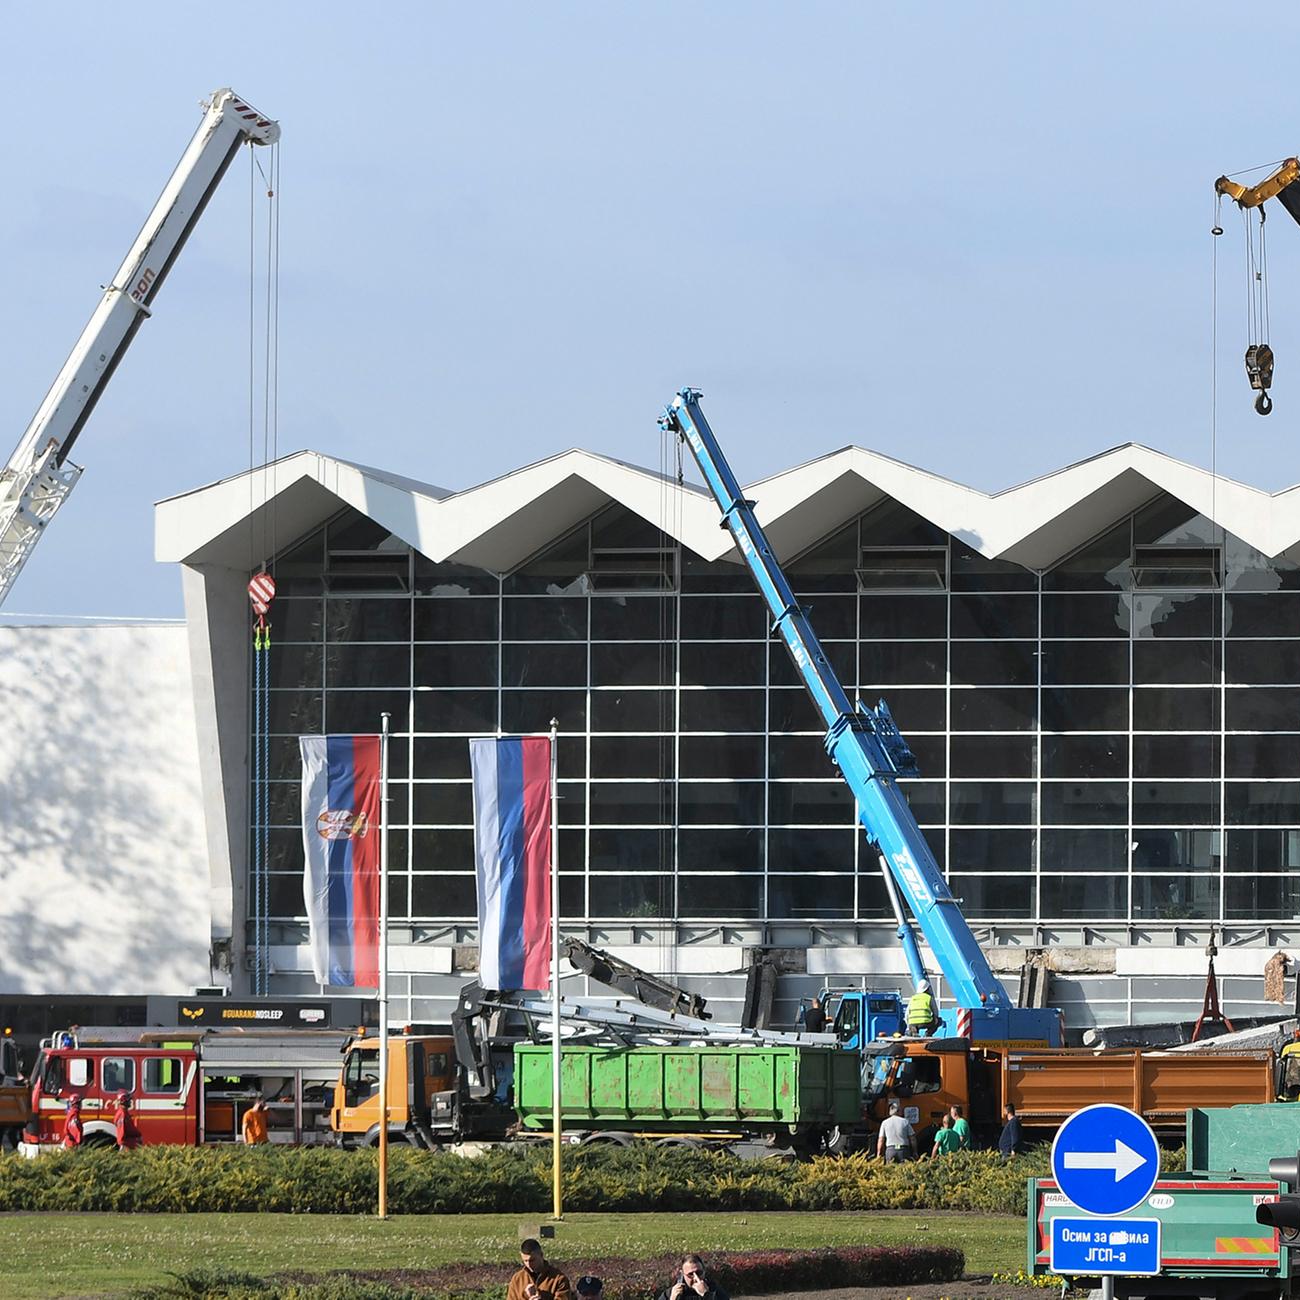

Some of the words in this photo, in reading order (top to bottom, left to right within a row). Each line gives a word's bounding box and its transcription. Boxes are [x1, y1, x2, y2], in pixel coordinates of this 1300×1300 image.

[1061, 1227, 1091, 1243] Осим
[1093, 1232, 1107, 1243] за
[1109, 1231, 1149, 1245] ила
[1085, 1247, 1127, 1263] ЈГСП-а
